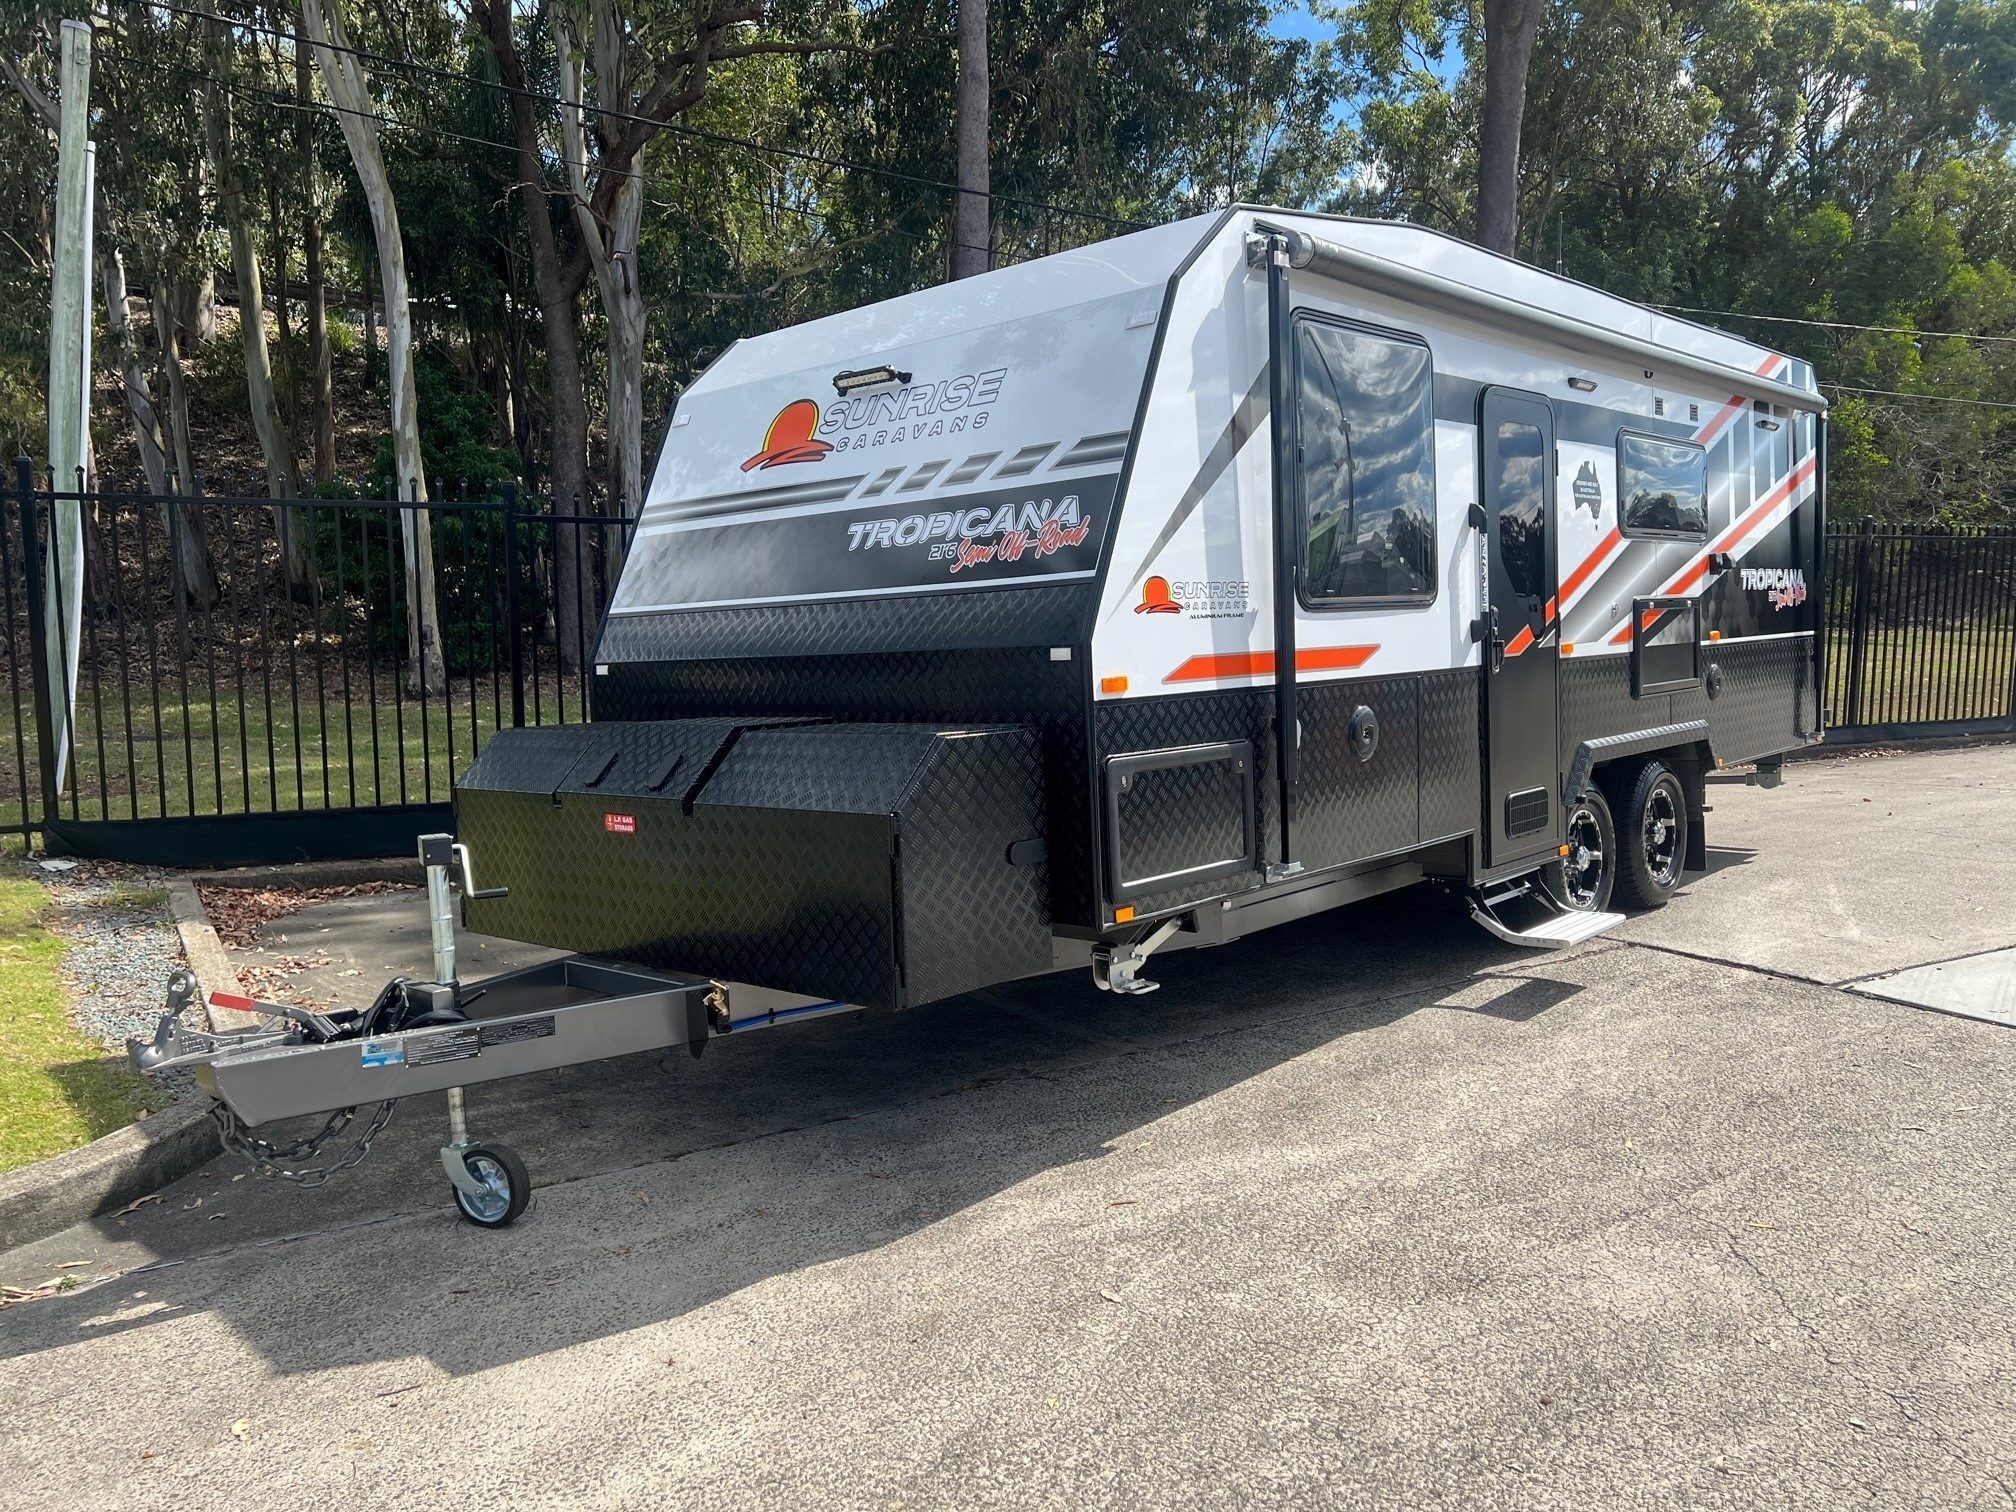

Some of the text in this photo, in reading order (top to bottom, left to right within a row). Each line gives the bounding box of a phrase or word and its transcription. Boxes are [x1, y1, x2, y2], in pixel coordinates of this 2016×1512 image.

[818, 367, 1008, 435] SUNRISE
[836, 411, 989, 453] CARAVANS
[847, 494, 1081, 551] TROPICANA
[950, 537, 999, 574] Semi
[997, 514, 1091, 563] Off-Road
[1171, 580, 1250, 599] SUNRISE
[1740, 568, 1804, 591] TROPICANA
[1184, 600, 1249, 611] CARAVANS
[622, 816, 633, 824] GAS
